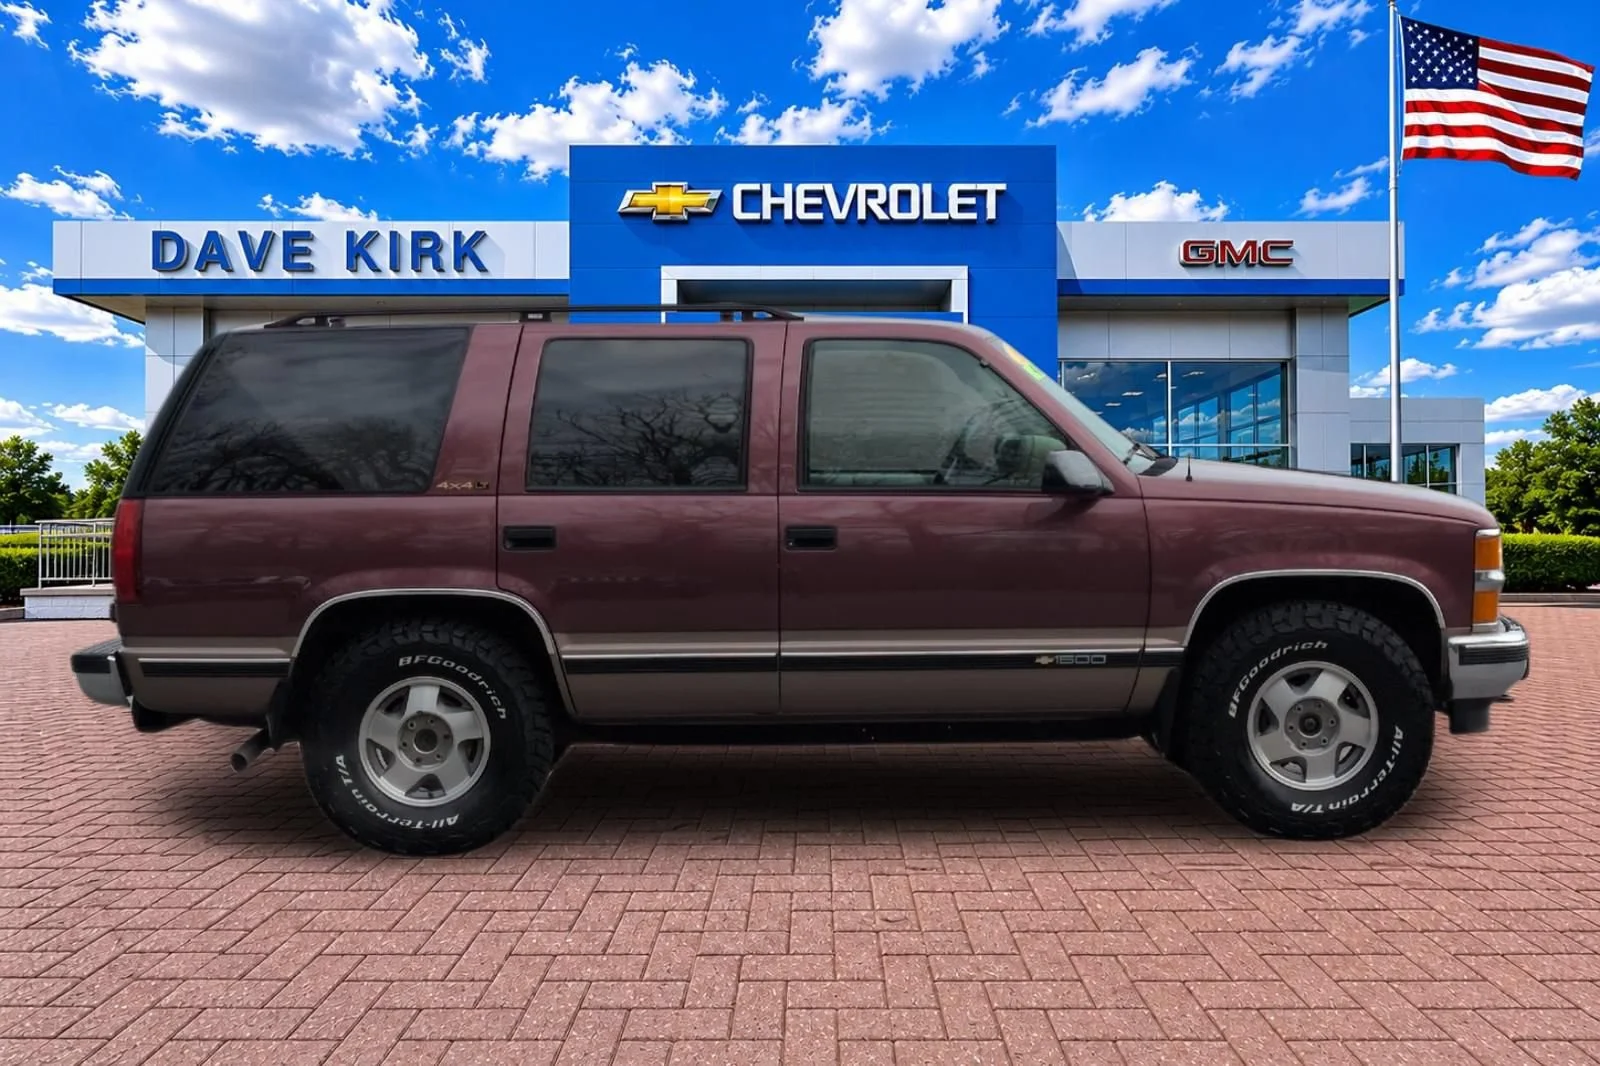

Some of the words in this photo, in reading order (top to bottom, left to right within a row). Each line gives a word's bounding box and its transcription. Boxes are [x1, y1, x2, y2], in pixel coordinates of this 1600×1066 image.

[732, 183, 1007, 221] CHEVROLET
[151, 230, 314, 273] DAVE
[345, 230, 488, 273] KIRK
[1180, 240, 1294, 267] GMC
[398, 654, 507, 720] BFGoodrich
[1228, 640, 1329, 719] BFGoodrich
[335, 754, 353, 786] T/A
[1328, 725, 1404, 811] All-Terrain
[351, 788, 460, 829] All-Terrain
[1290, 802, 1325, 814] T/A
